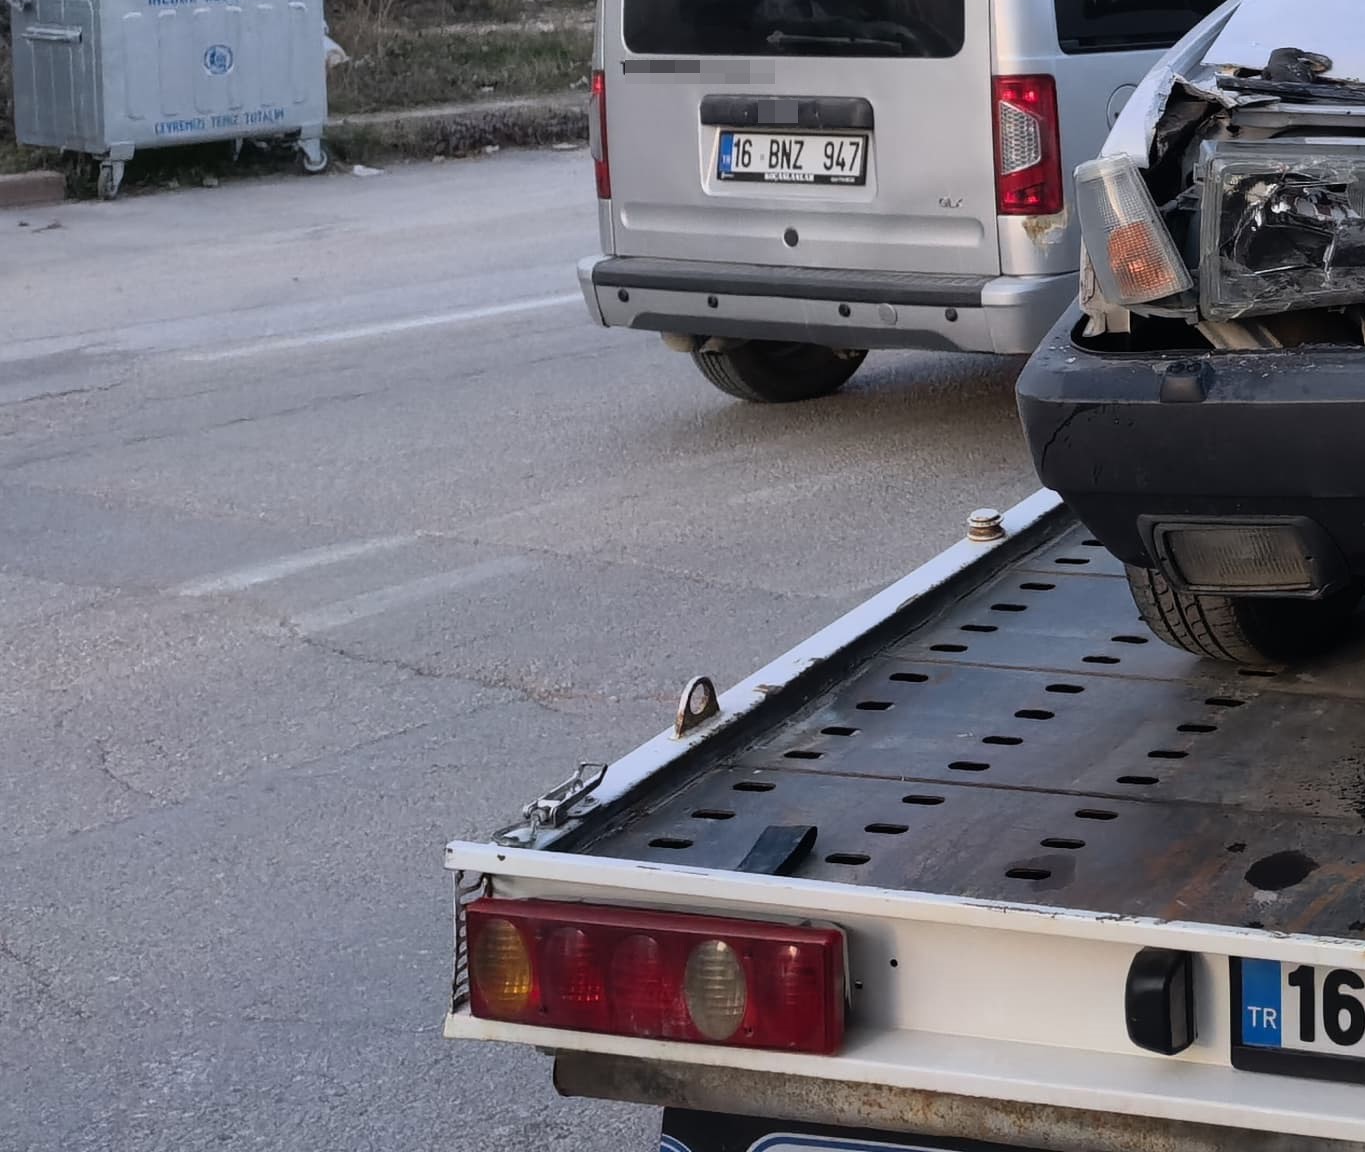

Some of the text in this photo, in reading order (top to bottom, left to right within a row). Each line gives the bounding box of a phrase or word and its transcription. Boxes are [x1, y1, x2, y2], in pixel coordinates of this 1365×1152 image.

[733, 137, 860, 172] 16 BNZ 947
[1247, 1005, 1278, 1030] TR
